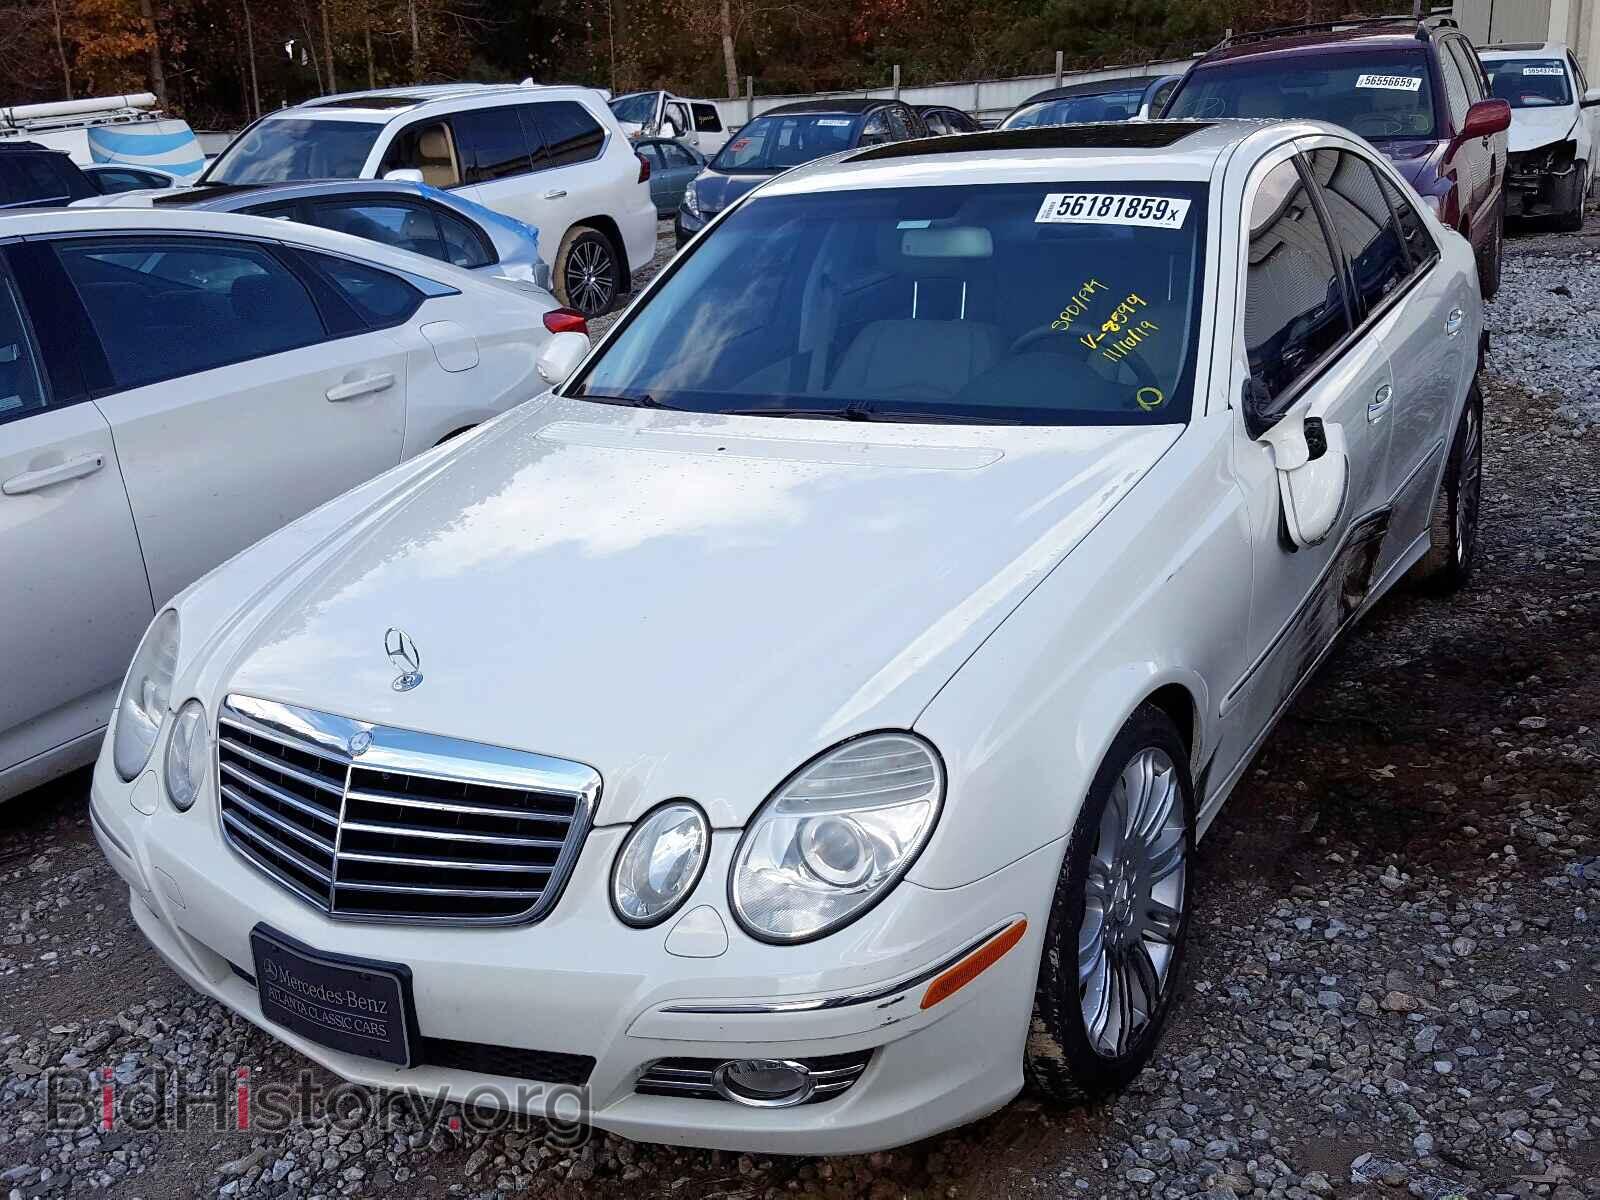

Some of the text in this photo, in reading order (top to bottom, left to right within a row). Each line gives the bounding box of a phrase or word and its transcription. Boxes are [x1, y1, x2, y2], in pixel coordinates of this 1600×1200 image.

[268, 985, 388, 1037] ATLANTA CLASSIC CARS
